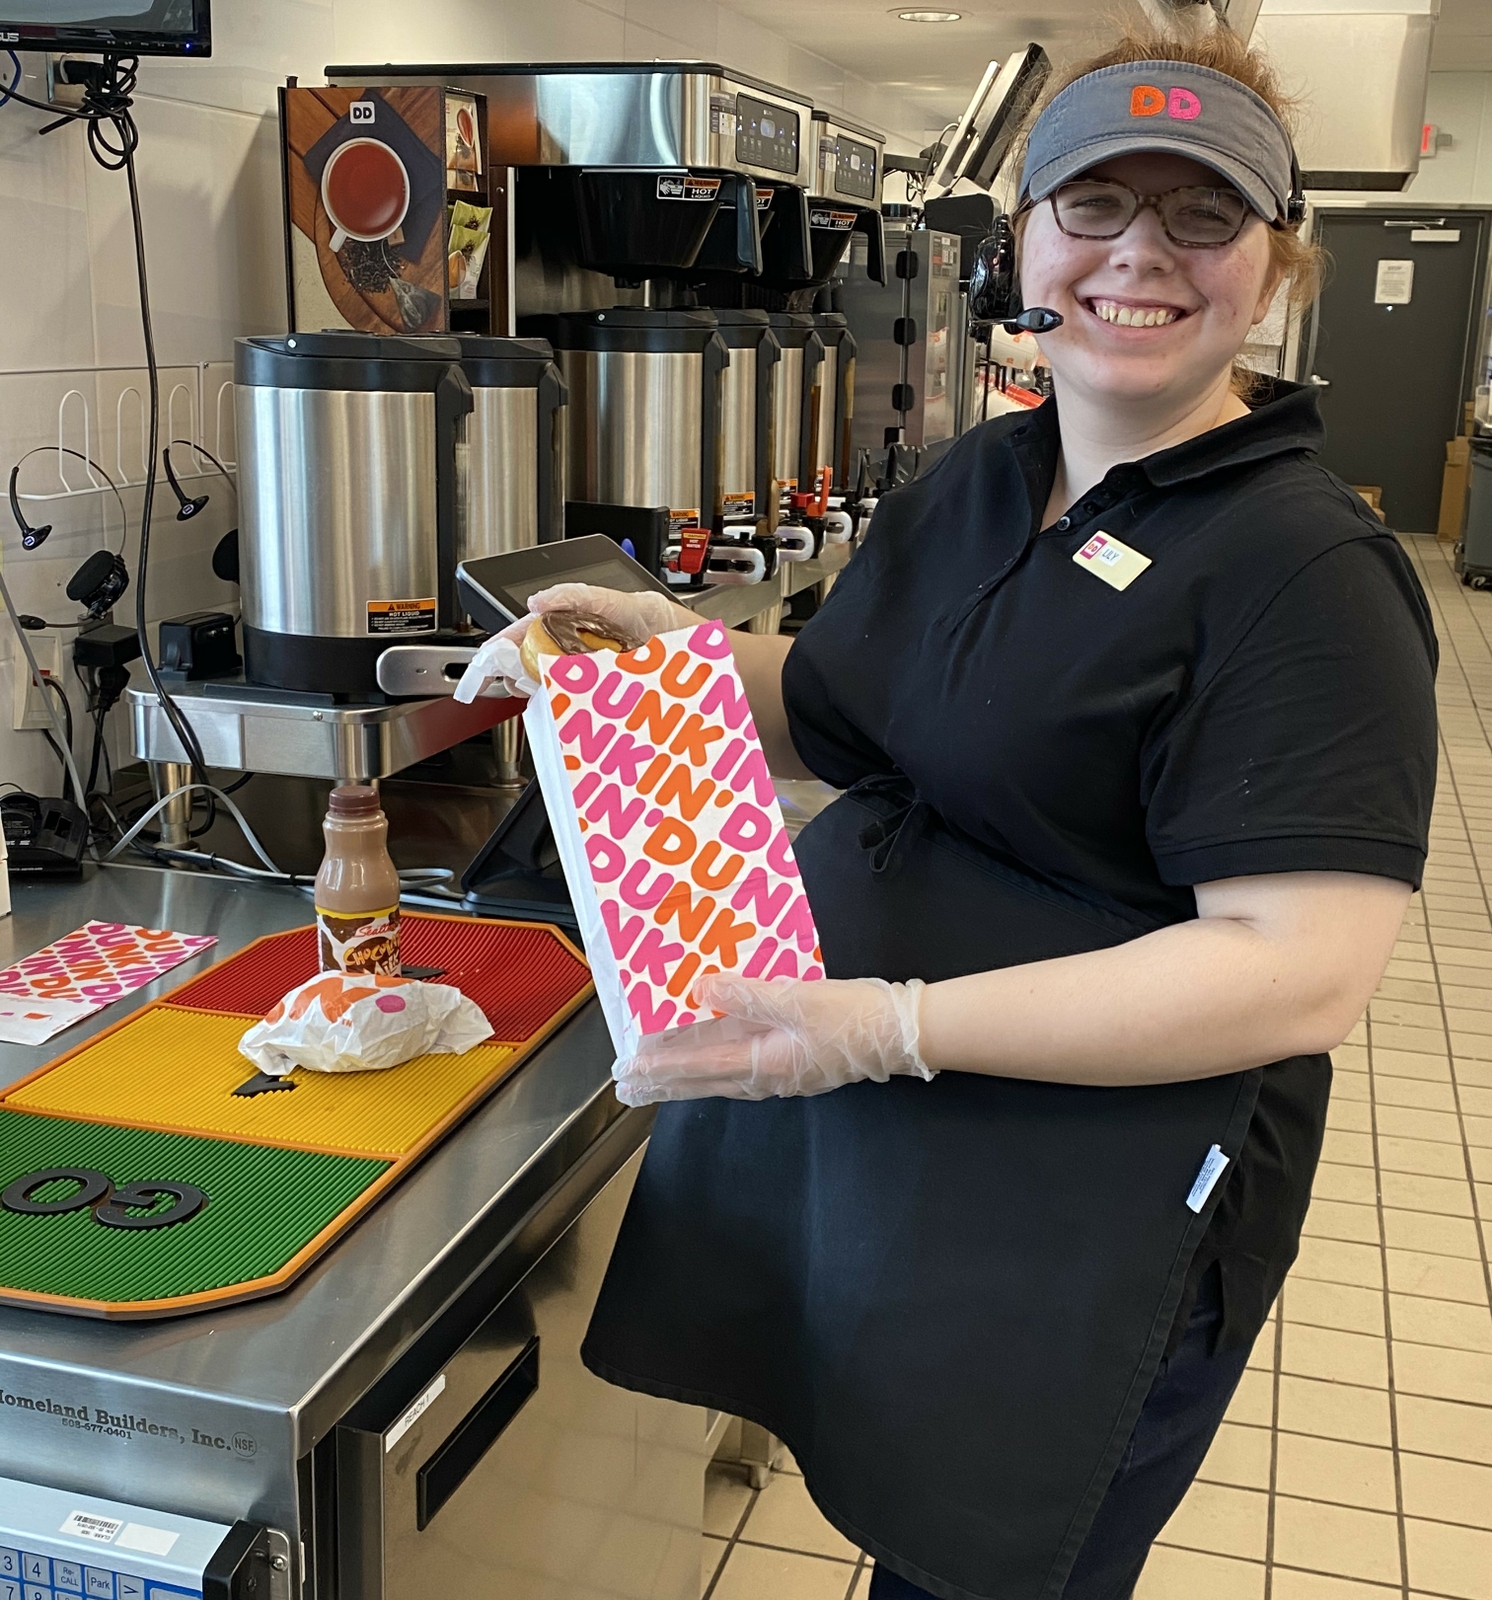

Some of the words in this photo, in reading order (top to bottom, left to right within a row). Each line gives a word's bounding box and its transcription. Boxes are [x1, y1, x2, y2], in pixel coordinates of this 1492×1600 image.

[0, 32, 19, 42] US
[1130, 85, 1201, 120] DD
[353, 107, 372, 119] DD
[1, 1167, 204, 1227] GO
[95, 1409, 186, 1444] Builders,
[192, 1428, 232, 1451] Inc.
[4, 1555, 13, 1571] 3
[32, 1562, 41, 1578] 4
[60, 1576, 79, 1587] CALL
[90, 1577, 110, 1590] Park
